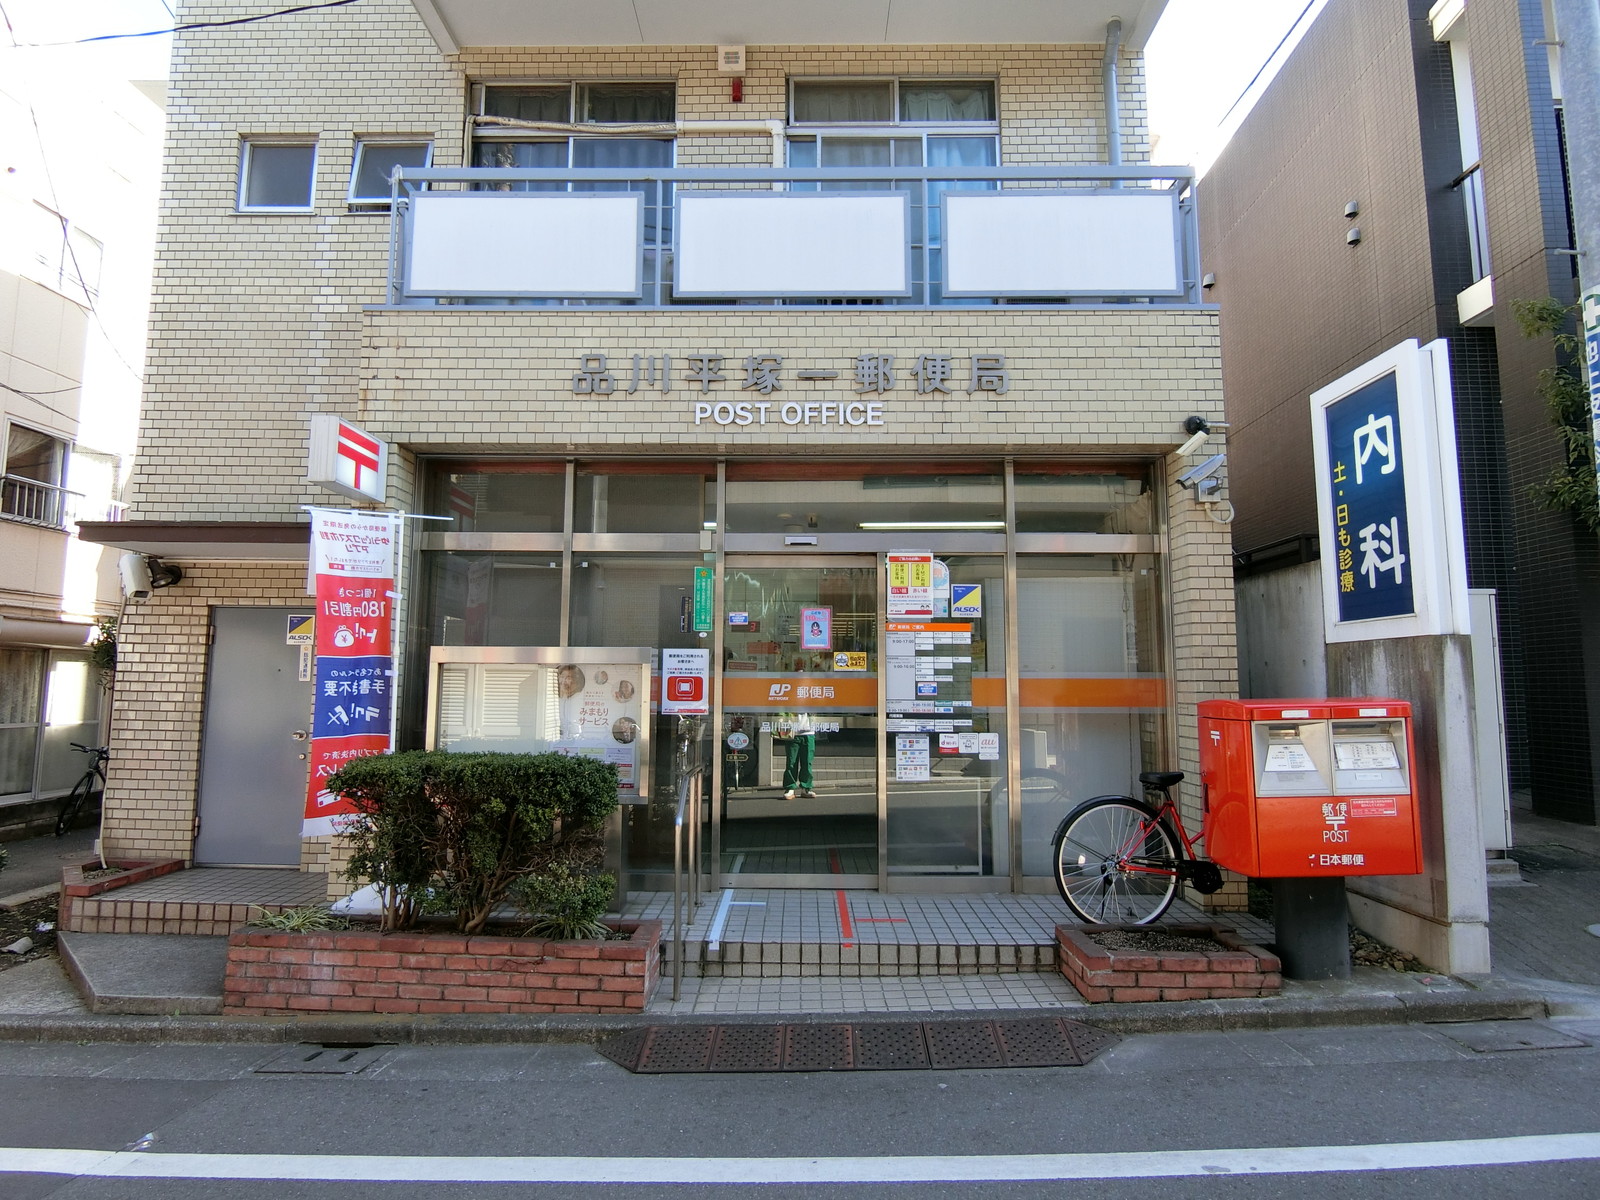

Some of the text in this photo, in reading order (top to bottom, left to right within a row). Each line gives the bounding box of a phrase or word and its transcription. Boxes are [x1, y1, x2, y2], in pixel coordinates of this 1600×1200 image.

[572, 353, 1010, 395] 品川平塚一郵便局
[694, 401, 885, 426] POST OFFICE
[1353, 413, 1406, 589] 内科
[1333, 461, 1355, 592] 土・日も診療
[796, 686, 835, 699] 郵便局
[579, 707, 609, 716] みまもり
[578, 717, 609, 726] サービス
[760, 721, 840, 733] 品川平塚郵便局
[981, 738, 997, 746] au
[1321, 802, 1348, 817] 郵便
[1323, 830, 1349, 842] POST
[1319, 854, 1364, 866] 日本郵便
